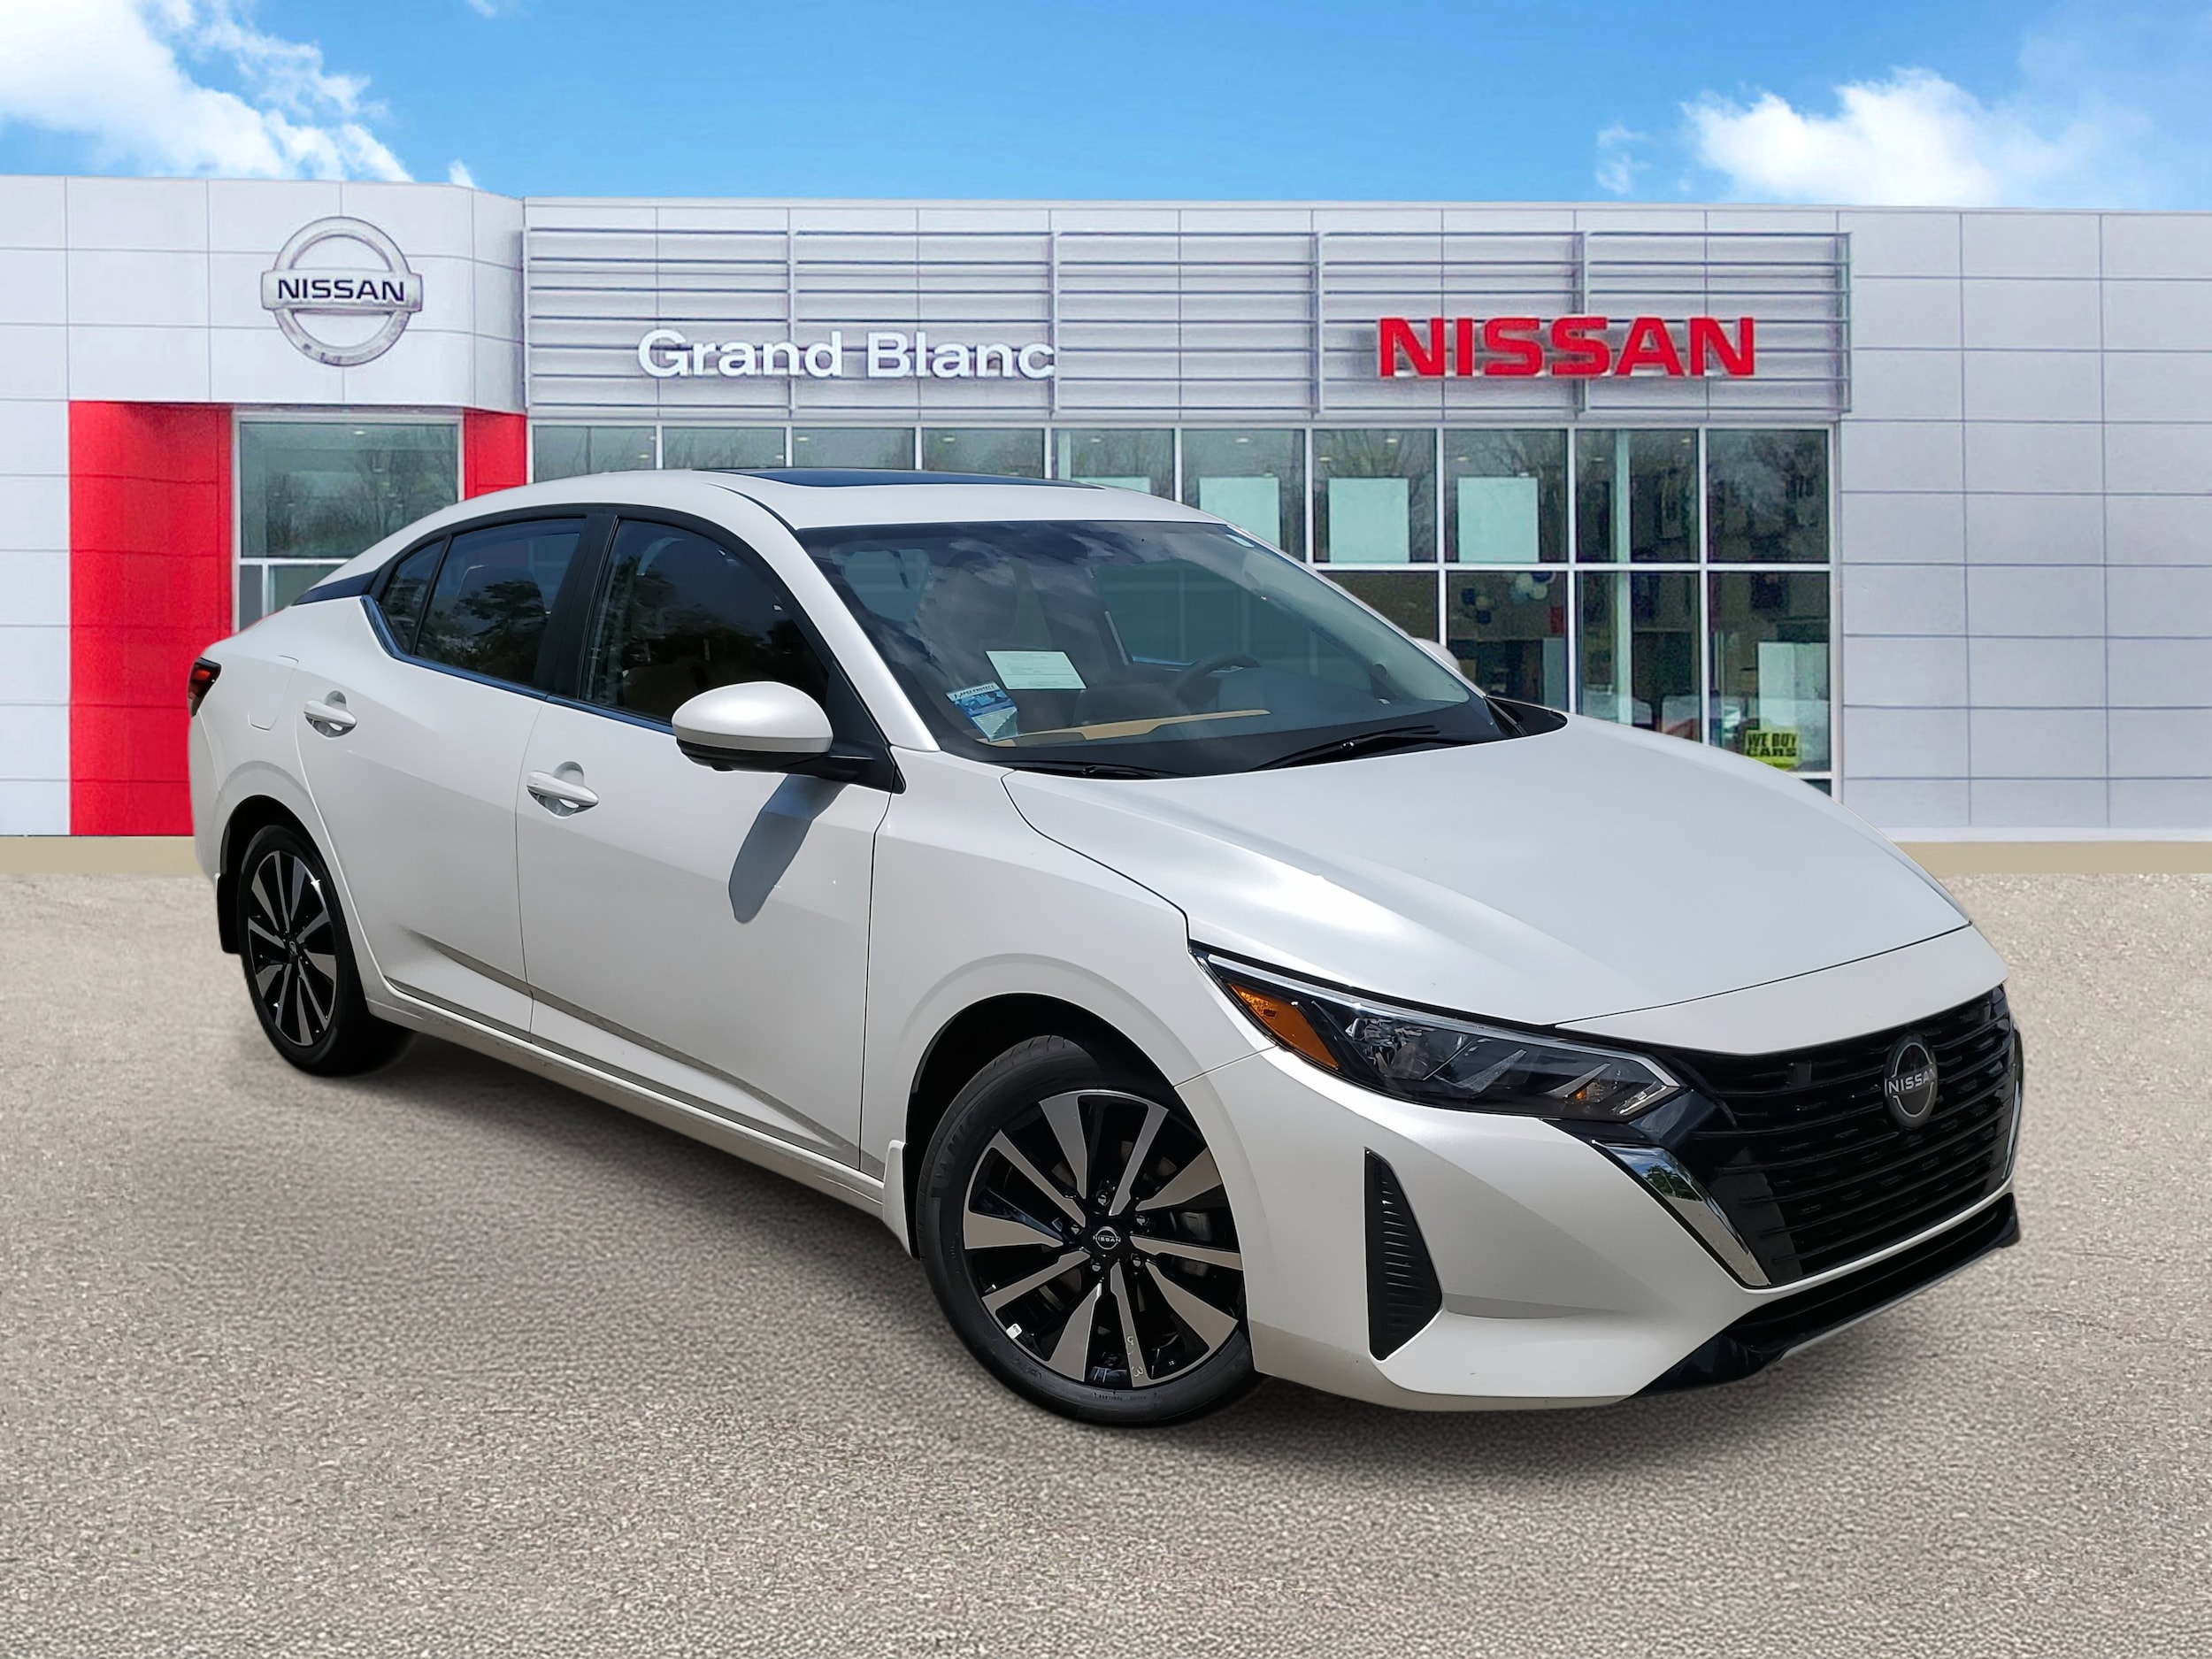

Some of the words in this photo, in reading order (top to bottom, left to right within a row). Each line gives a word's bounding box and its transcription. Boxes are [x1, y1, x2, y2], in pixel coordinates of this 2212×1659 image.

[278, 278, 404, 302] NISSAN
[637, 328, 841, 378] Grand
[866, 330, 1056, 380] Blanc
[1378, 316, 1755, 378] NISSAN
[1747, 732, 1768, 747] WE
[1771, 732, 1797, 747] BUY
[1746, 747, 1797, 757] CARS
